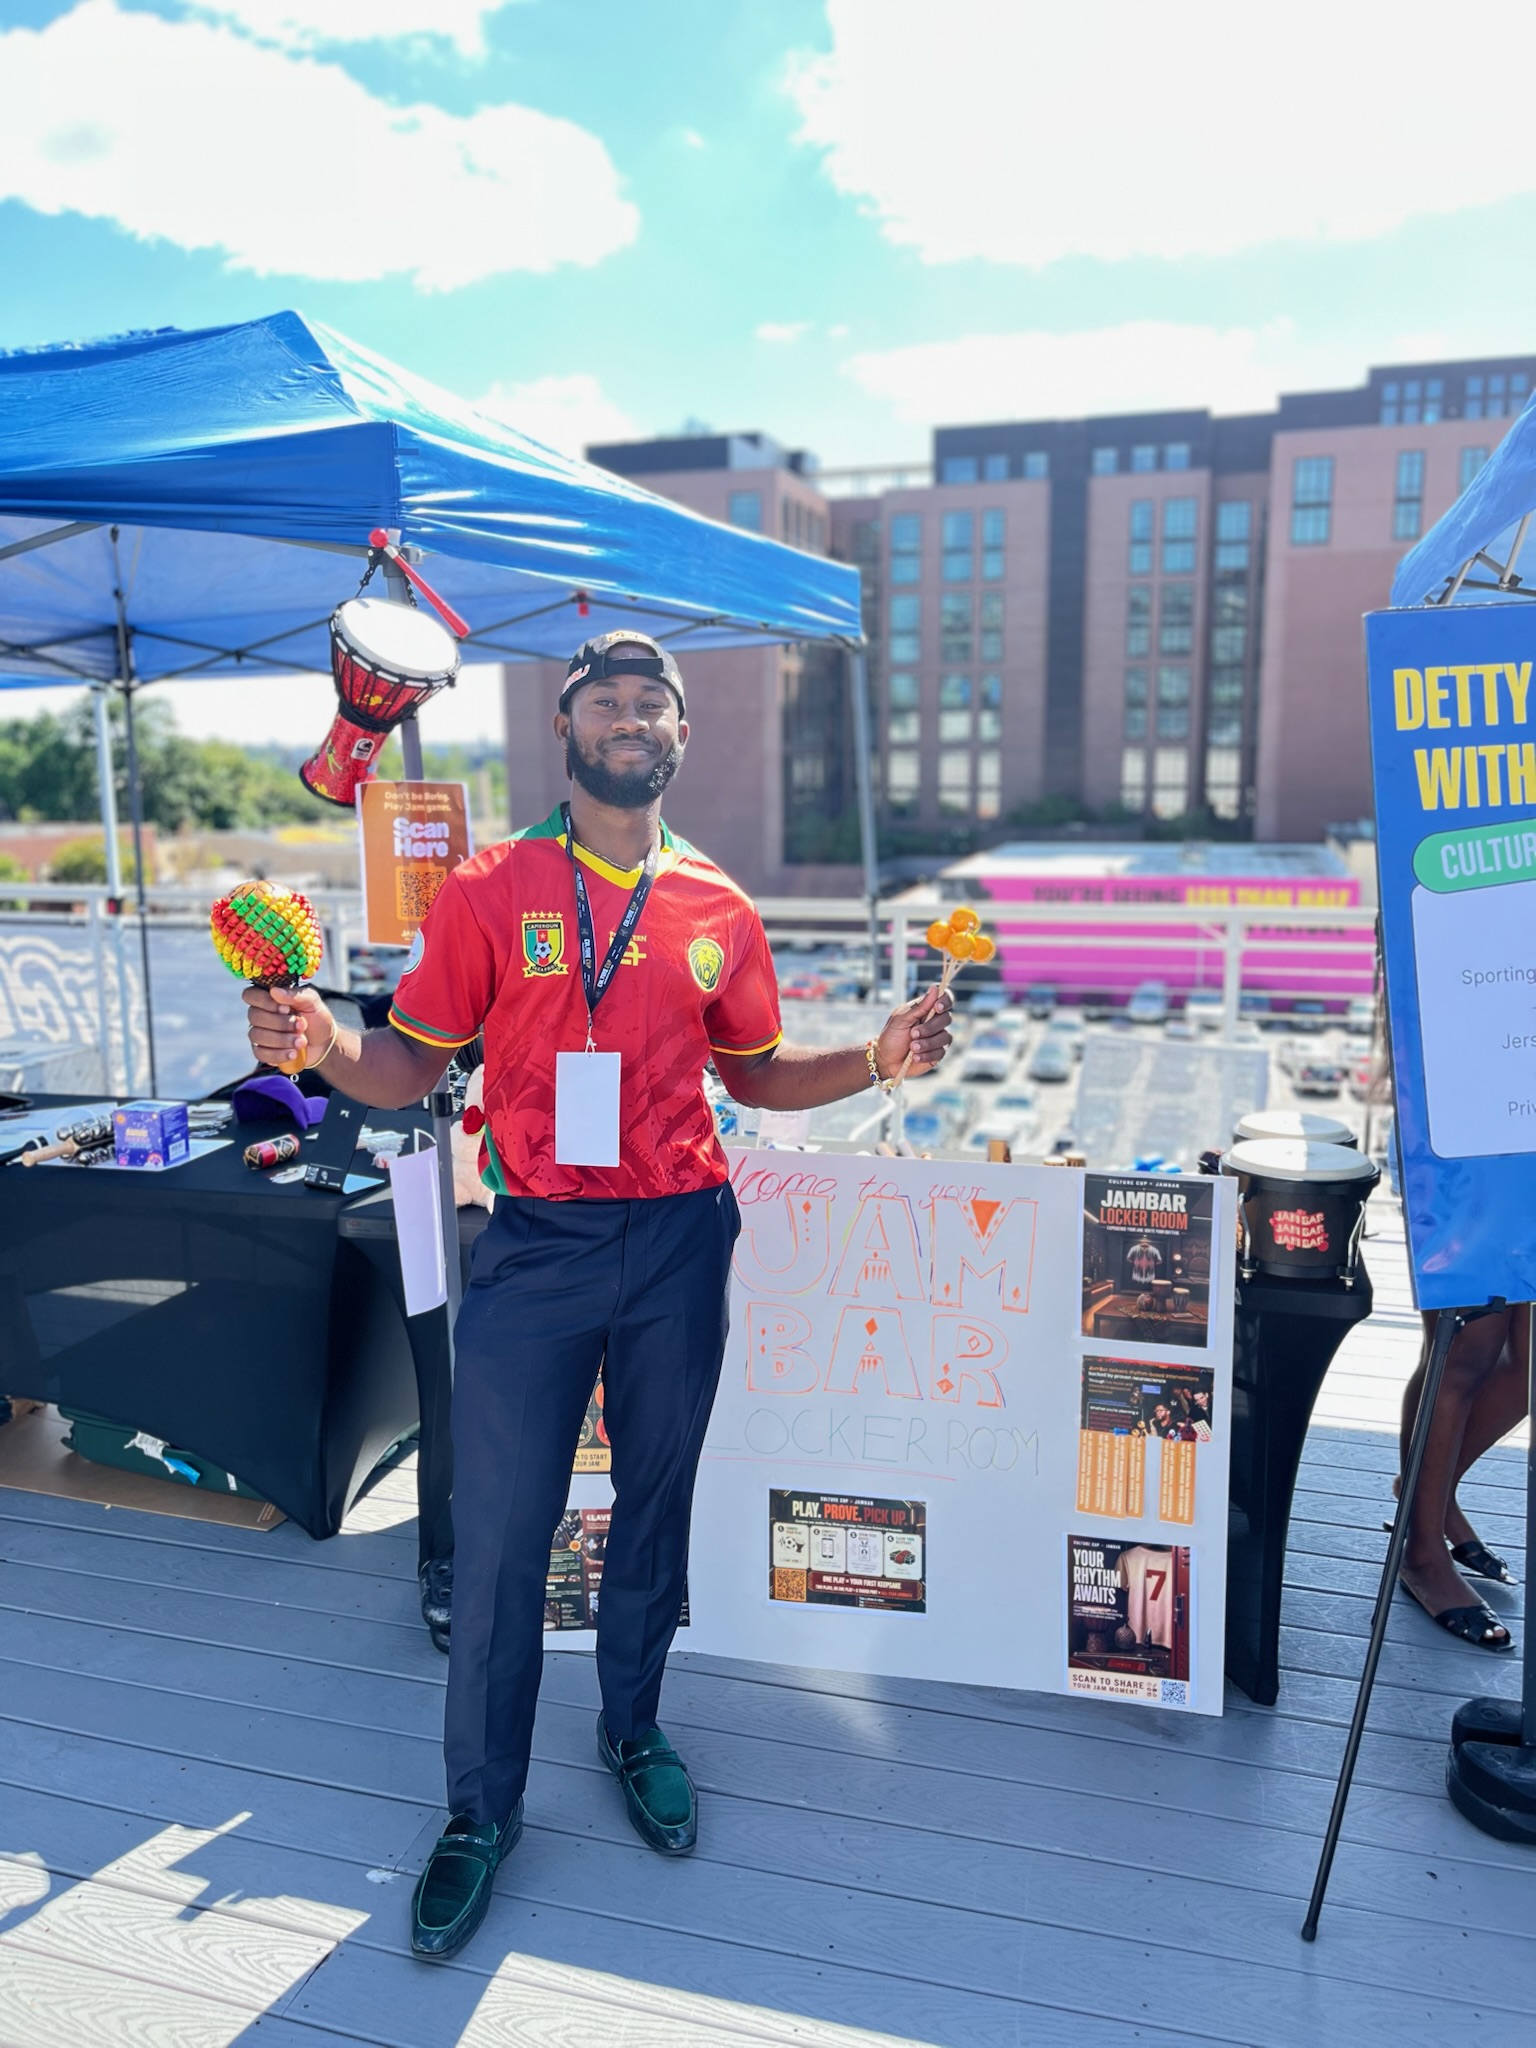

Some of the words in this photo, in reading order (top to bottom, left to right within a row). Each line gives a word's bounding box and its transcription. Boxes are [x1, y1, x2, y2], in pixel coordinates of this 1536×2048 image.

[1393, 661, 1533, 731] DETTY
[1414, 743, 1536, 810] WITH
[384, 803, 403, 812] Play
[404, 803, 424, 812] Jam
[426, 804, 452, 813] games.
[385, 792, 409, 800] Don't
[411, 792, 422, 800] be
[424, 792, 450, 802] Boring.
[393, 817, 449, 838] Scan
[394, 836, 448, 858] Here
[1440, 832, 1536, 880] CULTUR
[1462, 966, 1536, 988] Sporting
[730, 1155, 837, 1205] lcome,
[858, 1174, 898, 1202] to
[919, 1184, 986, 1209] your
[1100, 1190, 1186, 1213] JAMBAR
[1100, 1208, 1147, 1227] LOCKER
[1151, 1212, 1188, 1230] ROOM
[732, 1192, 1039, 1314] JAM
[745, 1302, 1009, 1408] BAR
[946, 1420, 1038, 1476] ROOM
[792, 1500, 821, 1518] PLAY.
[824, 1503, 861, 1521] PROVE.
[864, 1507, 888, 1524] PICK
[891, 1510, 907, 1526] UP.
[1073, 1548, 1104, 1568] YOUR
[822, 1575, 832, 1583] ONE
[850, 1578, 863, 1586] YOUR
[864, 1579, 877, 1587] FIRST
[877, 1580, 902, 1589] KEEPSAKE
[1073, 1566, 1121, 1588] RHYTHM
[1146, 1569, 1166, 1601] 7
[1073, 1584, 1116, 1605] AWAITS
[1072, 1674, 1097, 1683] SCAN
[1100, 1677, 1111, 1685] TO
[1114, 1679, 1144, 1689] SHARE
[1073, 1682, 1090, 1690] YOUR
[1093, 1684, 1106, 1692] JAM
[1109, 1686, 1138, 1696] MOMENT
